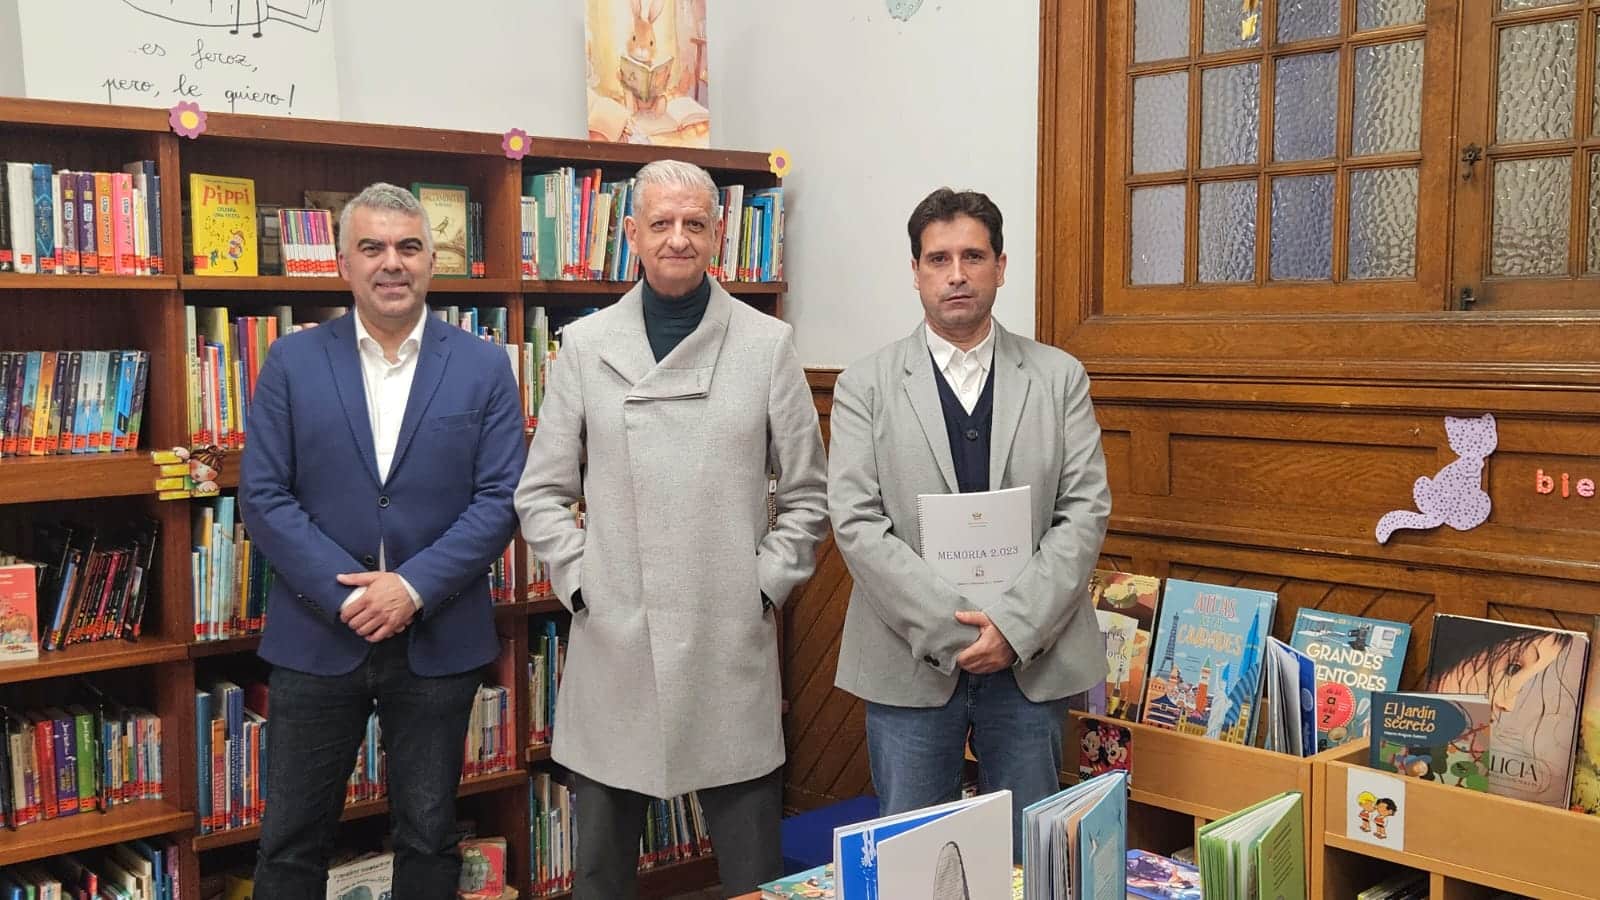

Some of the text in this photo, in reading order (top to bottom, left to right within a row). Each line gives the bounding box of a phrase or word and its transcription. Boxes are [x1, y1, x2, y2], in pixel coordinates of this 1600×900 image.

[139, 39, 258, 72] es feroz,
[102, 74, 296, 114] pero, le quiero!
[1536, 468, 1596, 498] bie
[938, 545, 1018, 560] MEMORIA 2.023
[1306, 643, 1384, 670] GRANDES
[1315, 664, 1388, 692] ENTORES
[1383, 702, 1398, 715] El
[1383, 717, 1436, 733] secreto
[1490, 754, 1538, 782] LICIA
